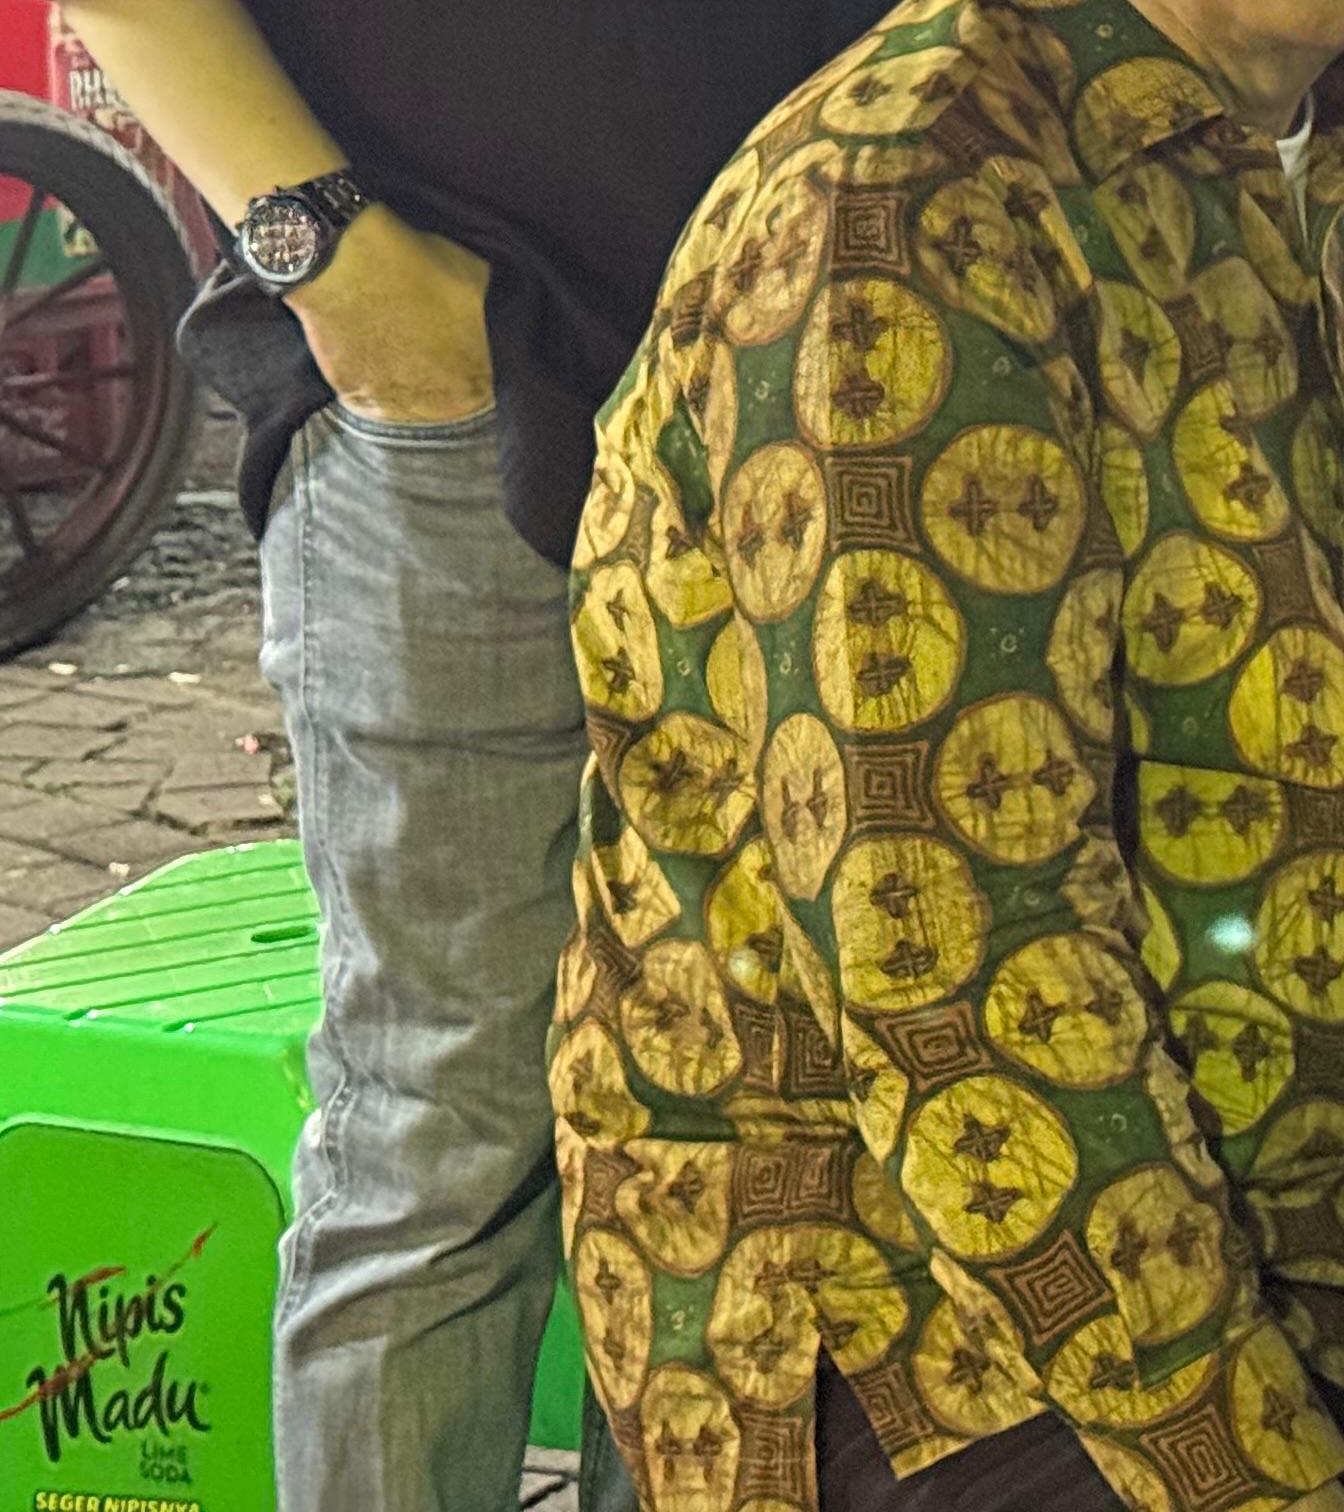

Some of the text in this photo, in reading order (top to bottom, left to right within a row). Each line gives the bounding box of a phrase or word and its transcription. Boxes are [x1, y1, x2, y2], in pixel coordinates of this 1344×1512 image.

[47, 1272, 187, 1368] Nipis
[26, 1349, 212, 1464] Madu
[35, 1490, 101, 1512] SEGER
